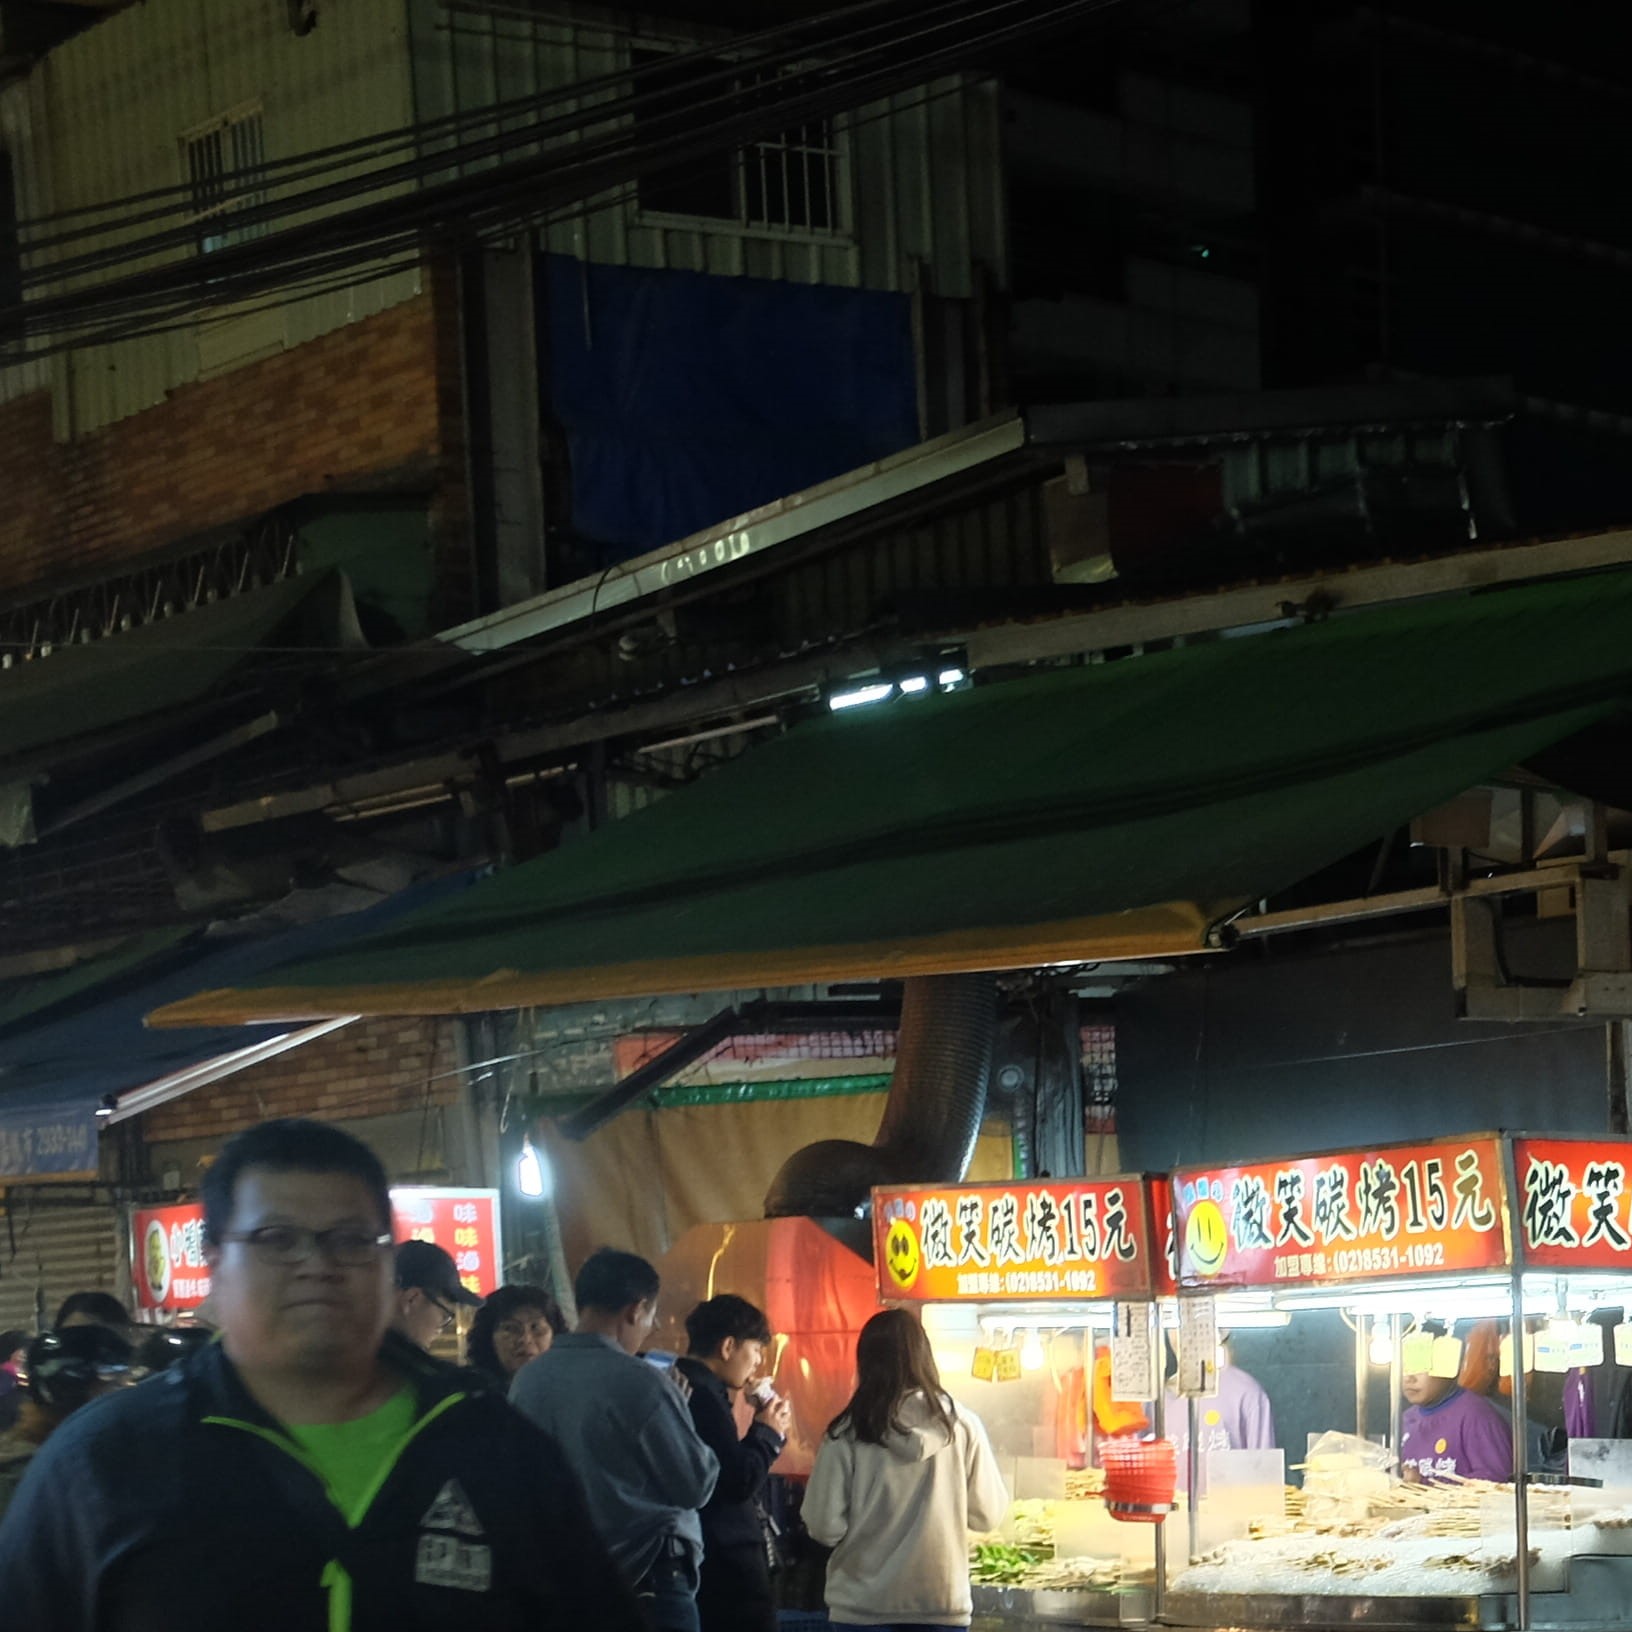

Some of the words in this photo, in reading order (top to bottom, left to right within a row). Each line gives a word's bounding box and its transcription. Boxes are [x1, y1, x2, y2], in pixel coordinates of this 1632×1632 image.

[921, 1188, 1137, 1269] 微笑碳烤15元
[1232, 1149, 1497, 1252] 微笑碳烤15元
